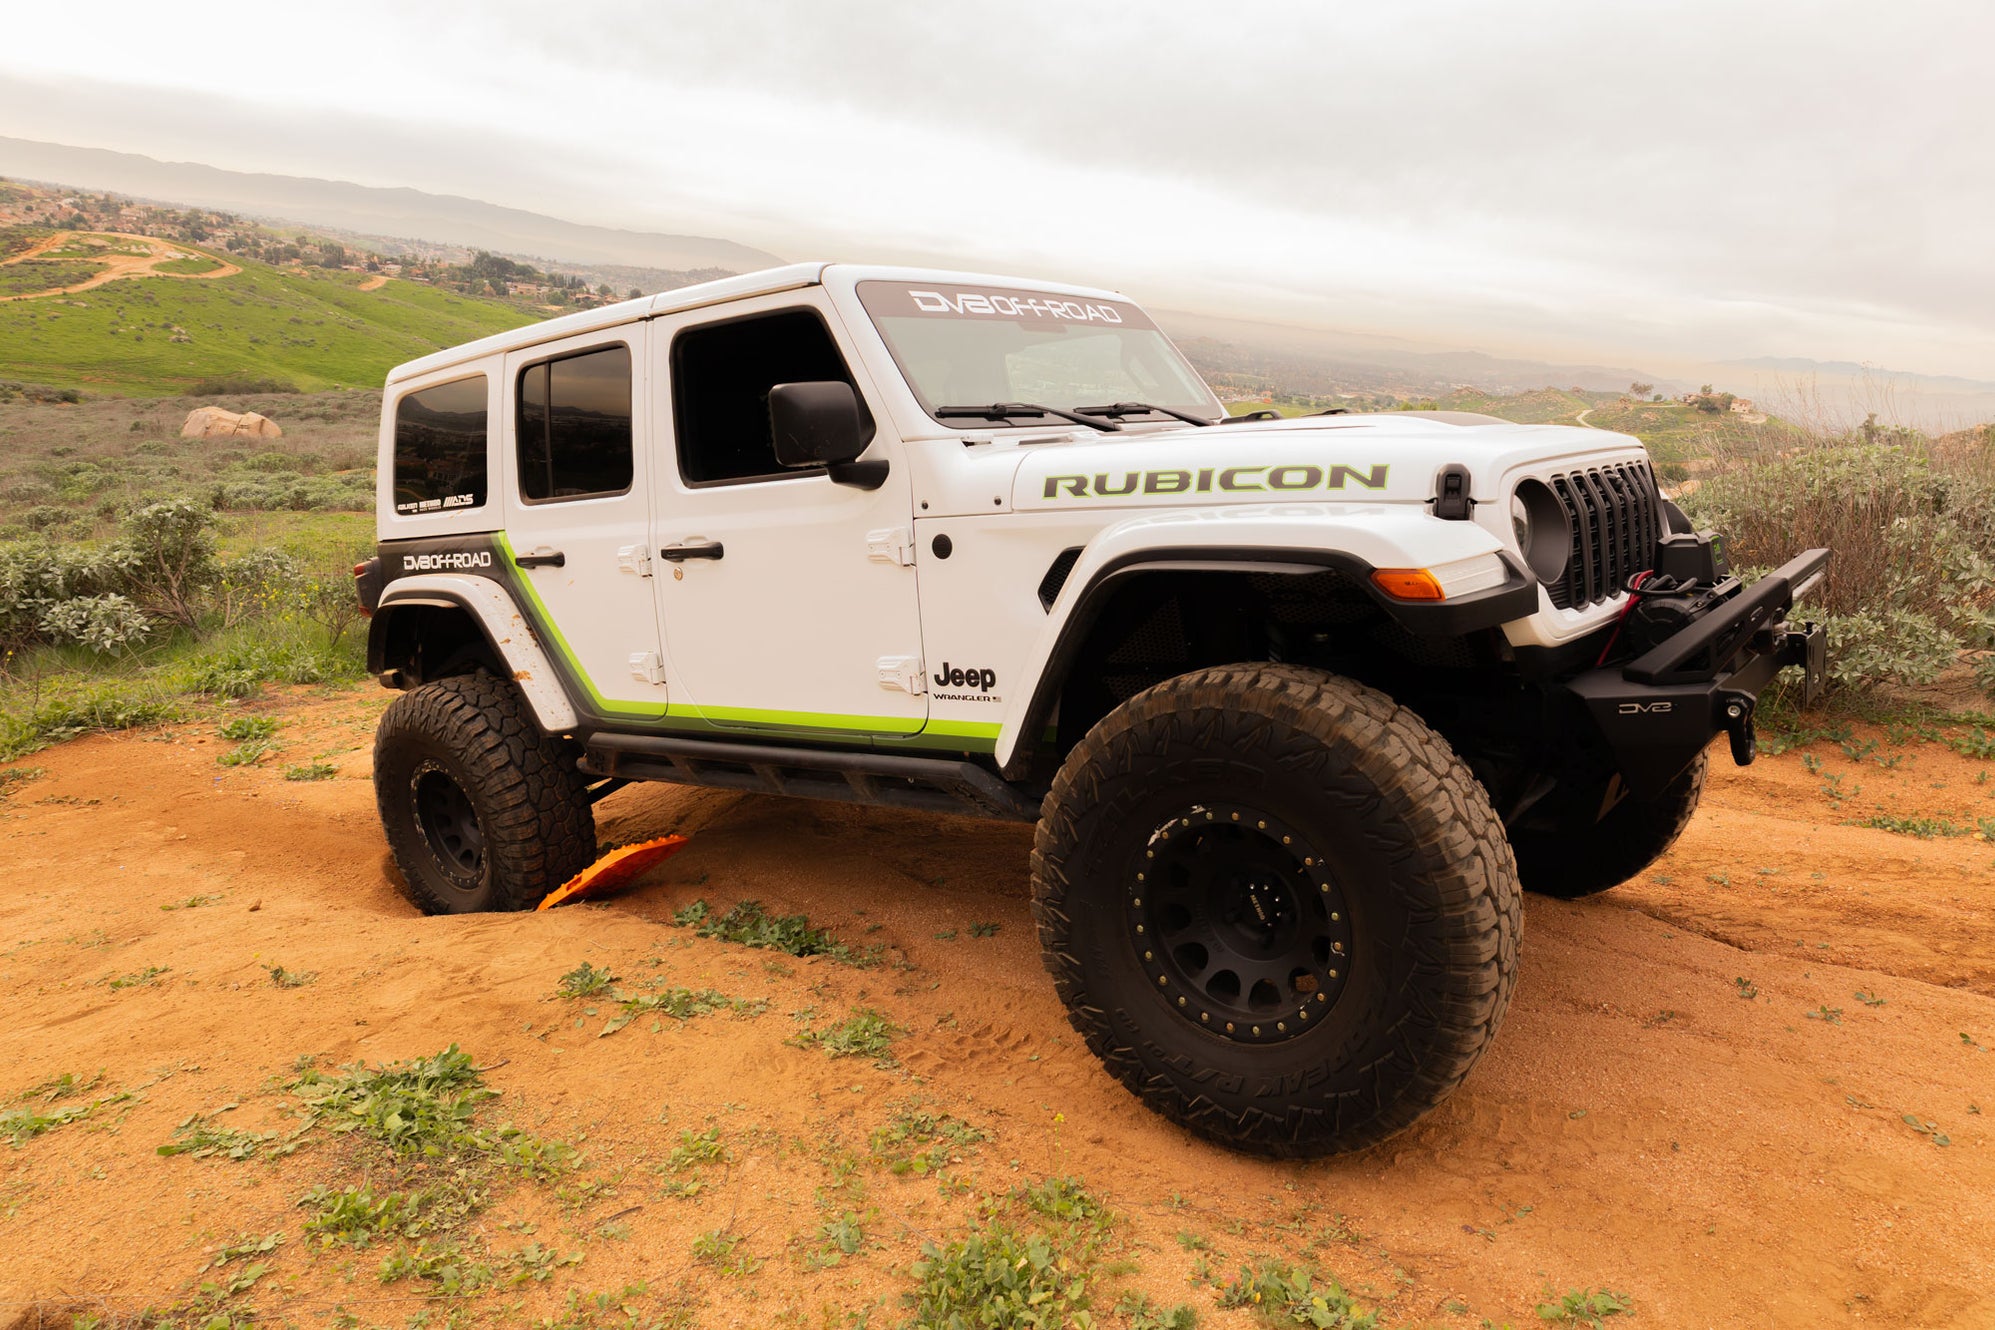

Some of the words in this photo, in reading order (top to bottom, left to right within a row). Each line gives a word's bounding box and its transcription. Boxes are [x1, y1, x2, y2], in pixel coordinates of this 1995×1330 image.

[1042, 463, 1391, 500] RUBICON
[934, 662, 996, 693] Jeep
[933, 693, 991, 702] WRANGLER
